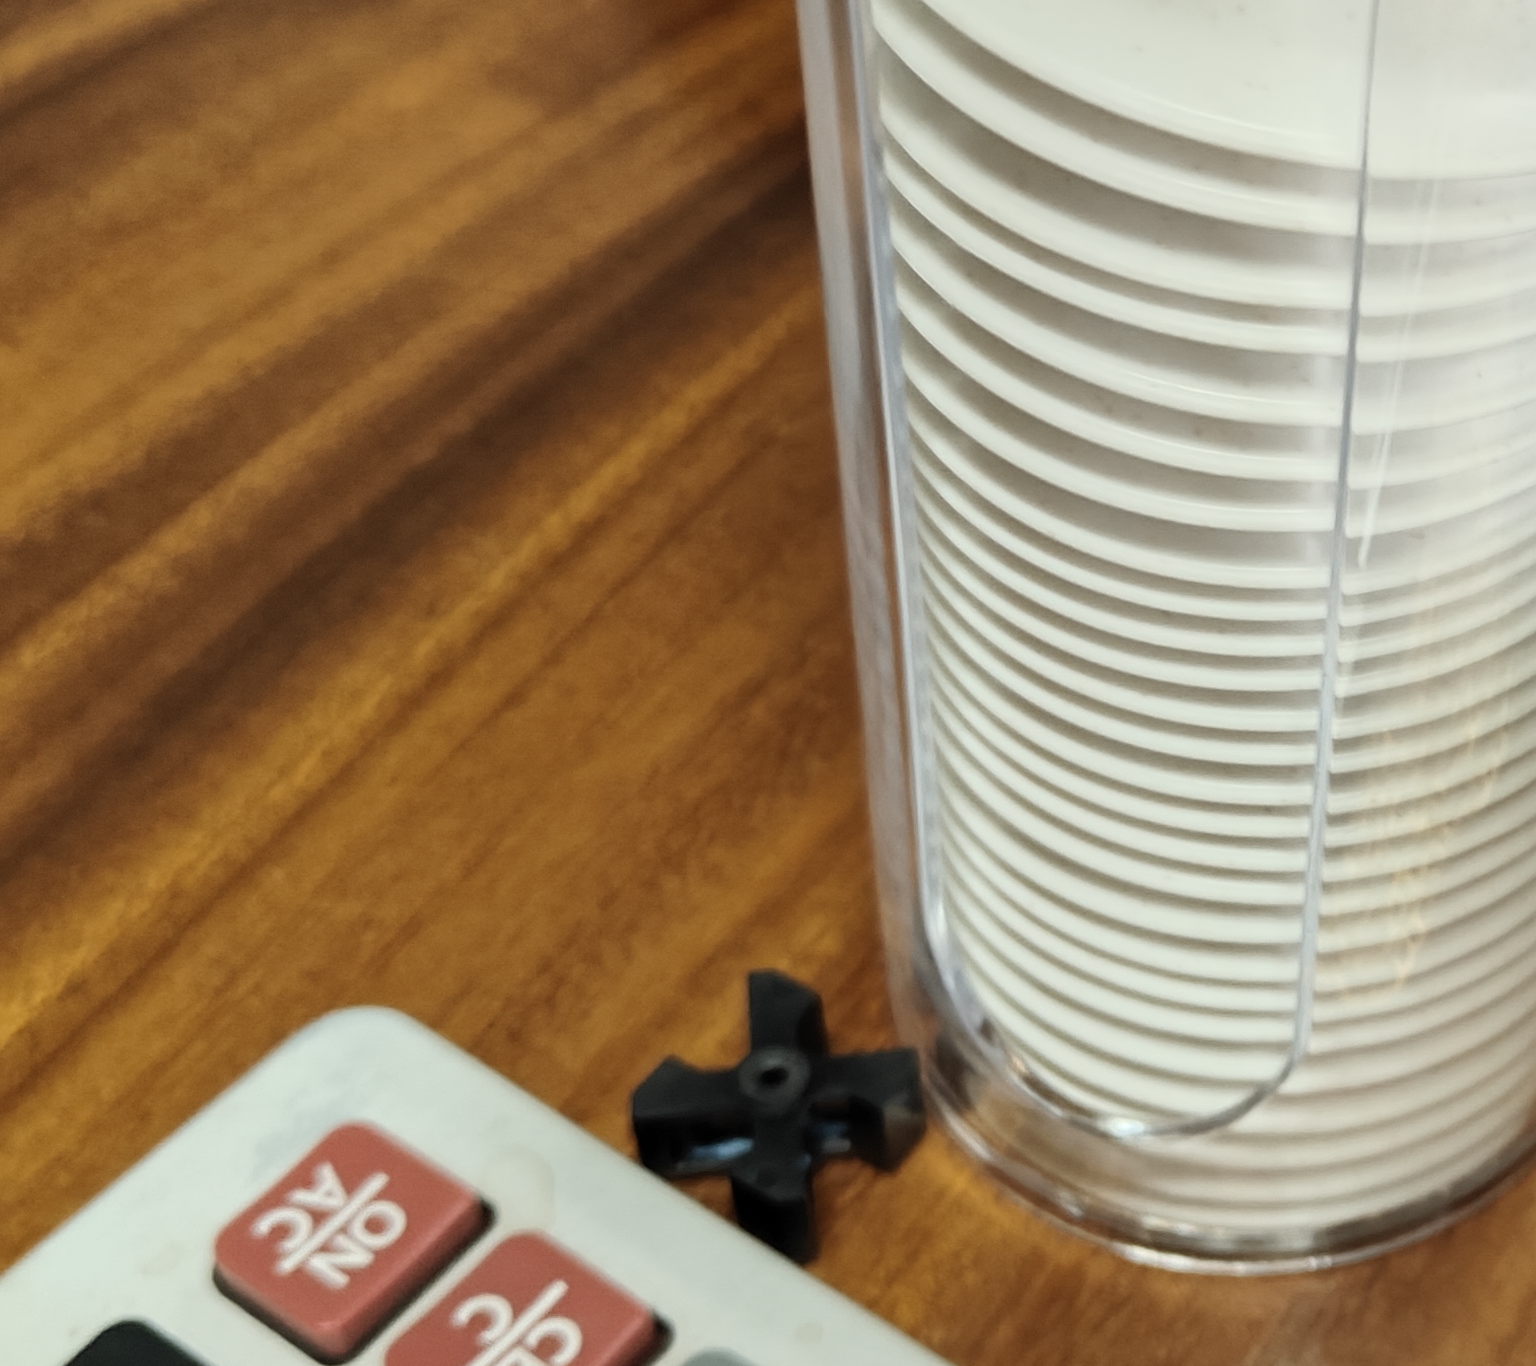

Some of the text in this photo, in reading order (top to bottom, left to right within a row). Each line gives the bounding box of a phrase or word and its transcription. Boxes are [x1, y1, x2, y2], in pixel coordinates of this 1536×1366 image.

[253, 1162, 346, 1259] AC
[305, 1198, 408, 1290] ON
[451, 1292, 516, 1340] C
